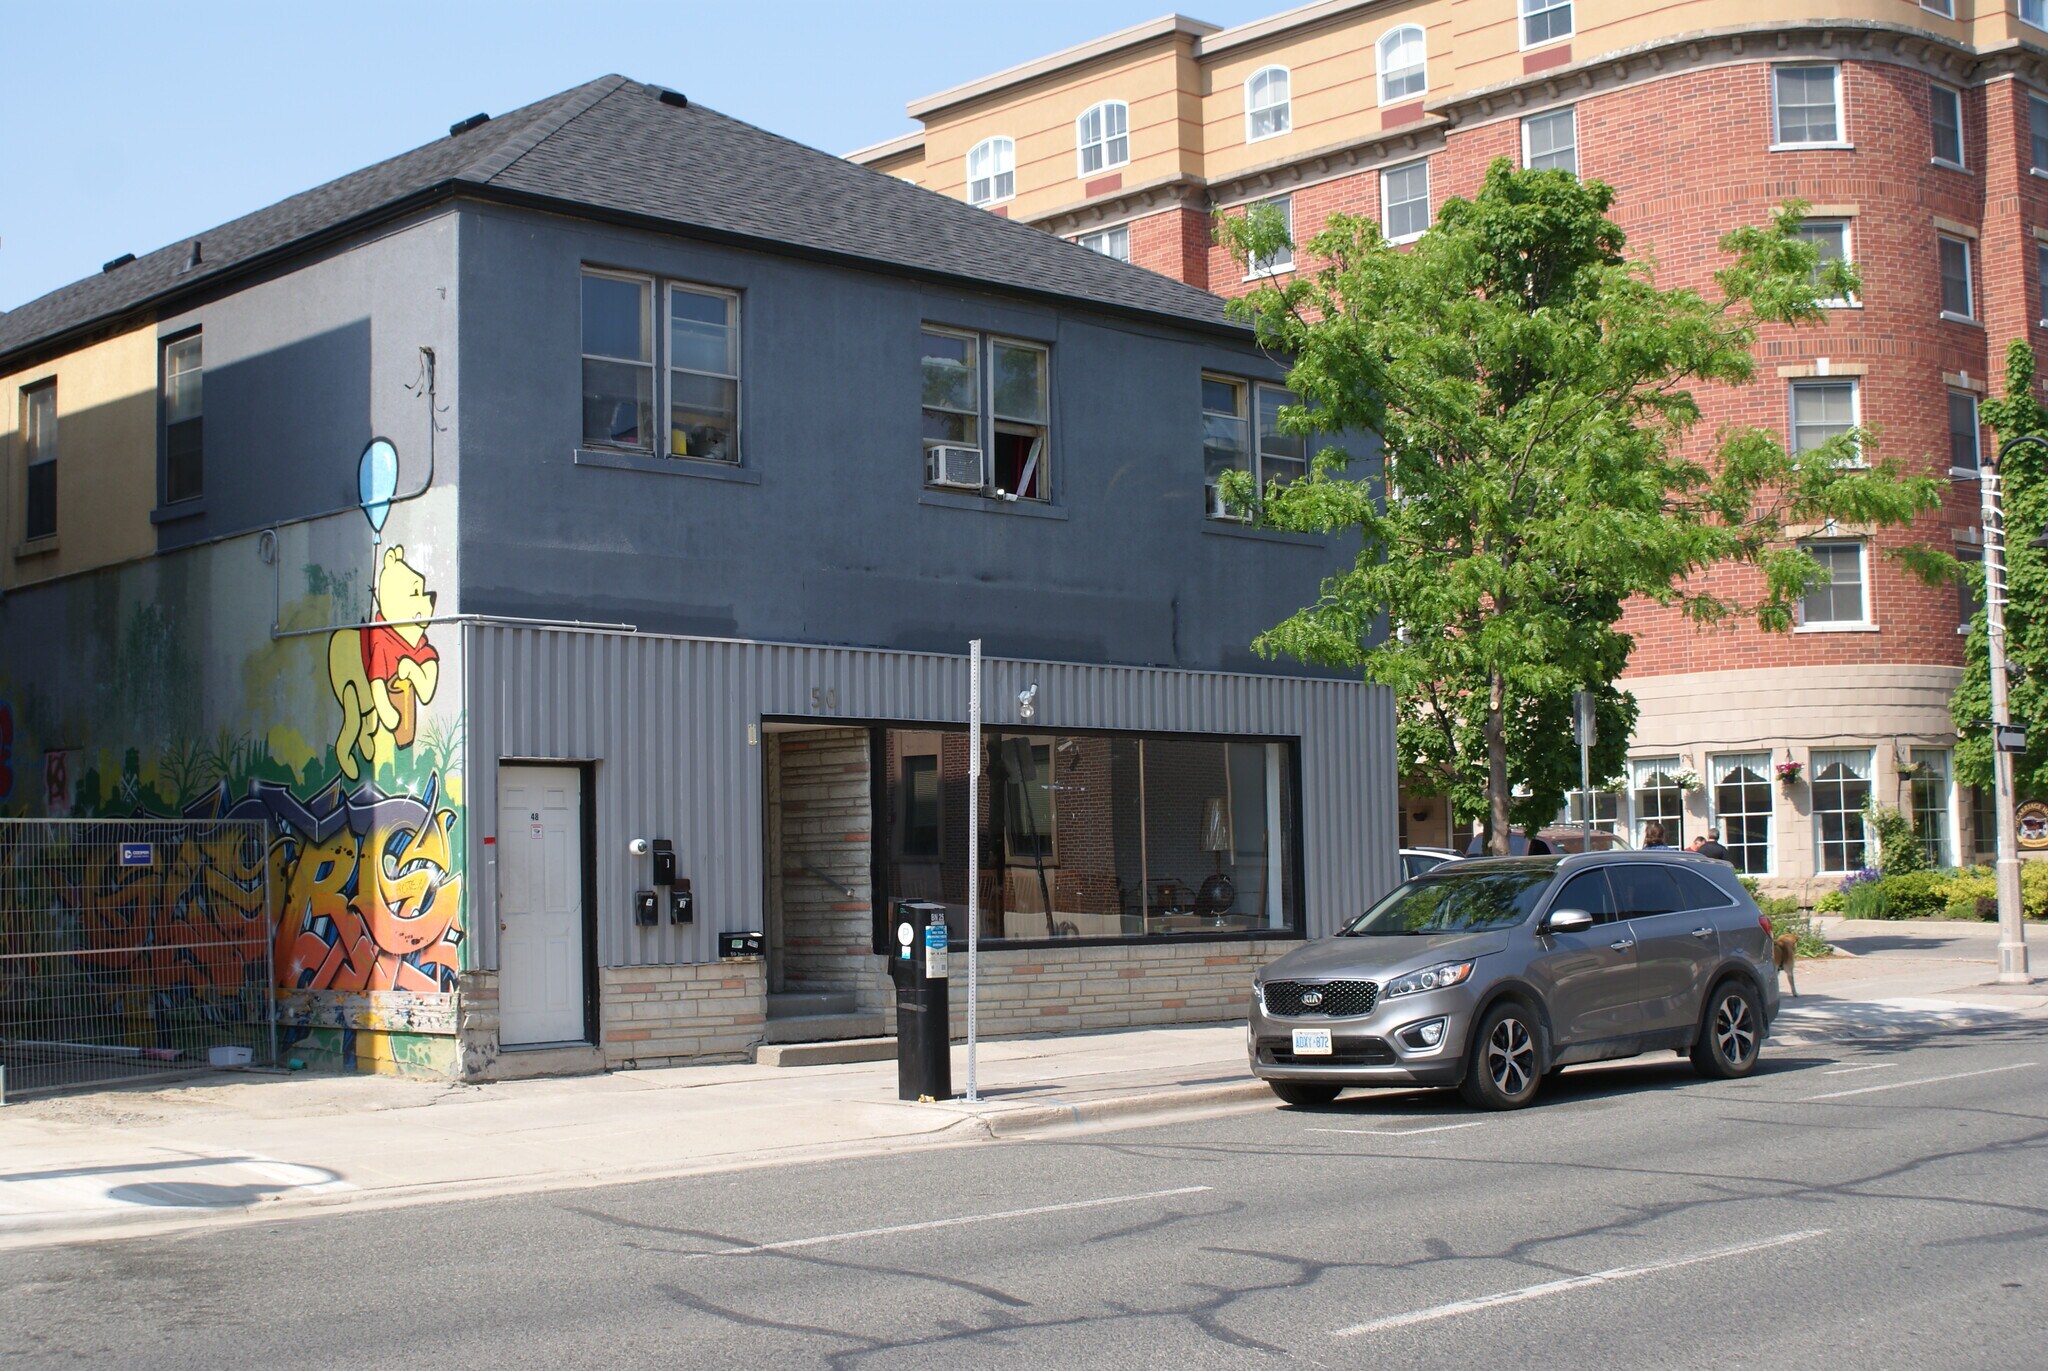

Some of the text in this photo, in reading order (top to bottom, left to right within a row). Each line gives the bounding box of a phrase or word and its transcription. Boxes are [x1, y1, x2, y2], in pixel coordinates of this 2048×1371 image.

[811, 687, 837, 709] 50
[530, 812, 540, 821] 48
[931, 913, 945, 921] BN 25
[1303, 994, 1319, 1004] KIA
[1315, 1036, 1329, 1048] 872
